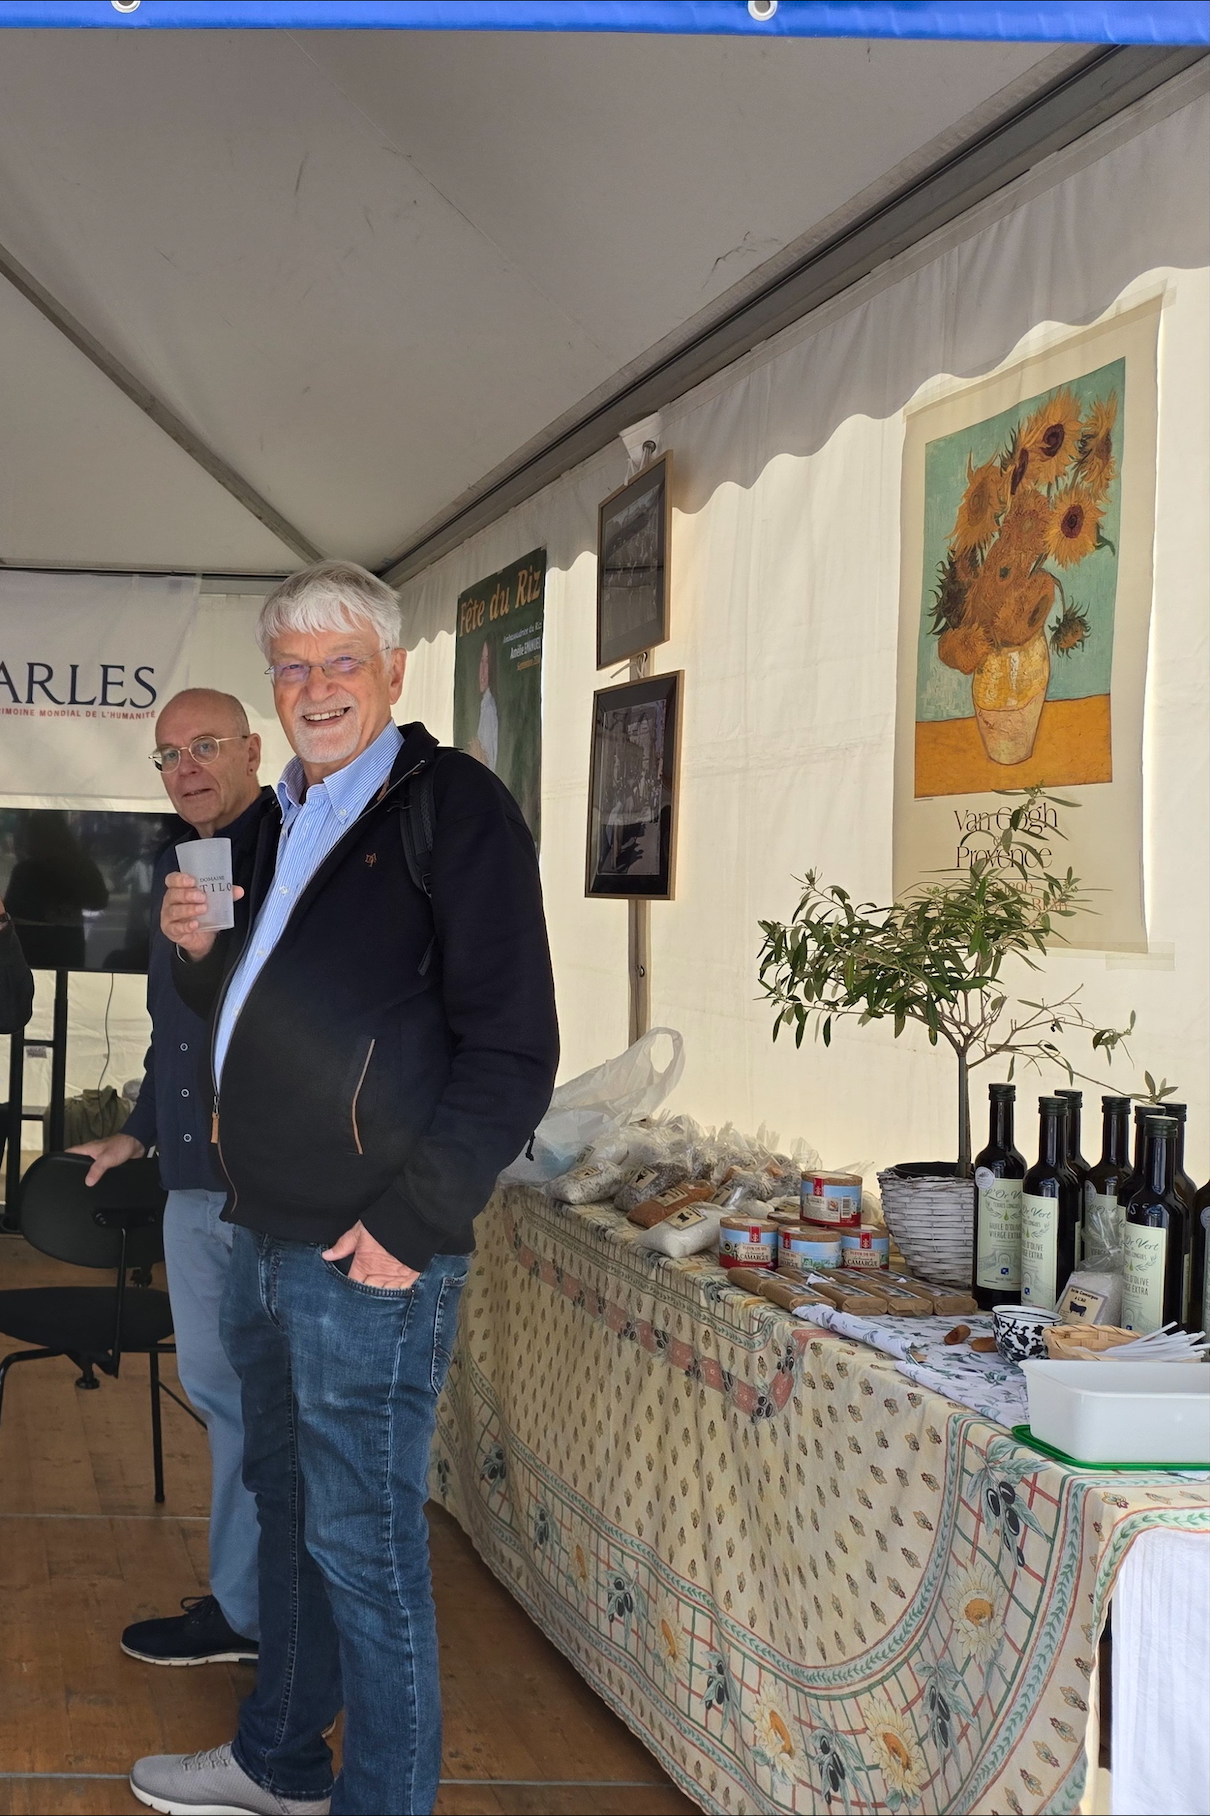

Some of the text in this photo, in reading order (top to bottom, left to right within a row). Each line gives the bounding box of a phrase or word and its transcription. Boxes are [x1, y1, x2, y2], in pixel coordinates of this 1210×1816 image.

[459, 565, 541, 638] Fête du Riz
[39, 708, 81, 718] MONDIAL
[85, 709, 98, 718] DE
[102, 709, 157, 720] L'HUMANITÉ
[954, 802, 1058, 835] Van Gogh
[956, 846, 1053, 869] Provence
[200, 882, 232, 894] TILO
[1031, 1207, 1052, 1219] Vert
[989, 1231, 1006, 1239] VIERGE
[1135, 1238, 1159, 1251] Vert
[847, 1259, 878, 1267] CAMARGUE
[1132, 1286, 1149, 1296] EXTRA
